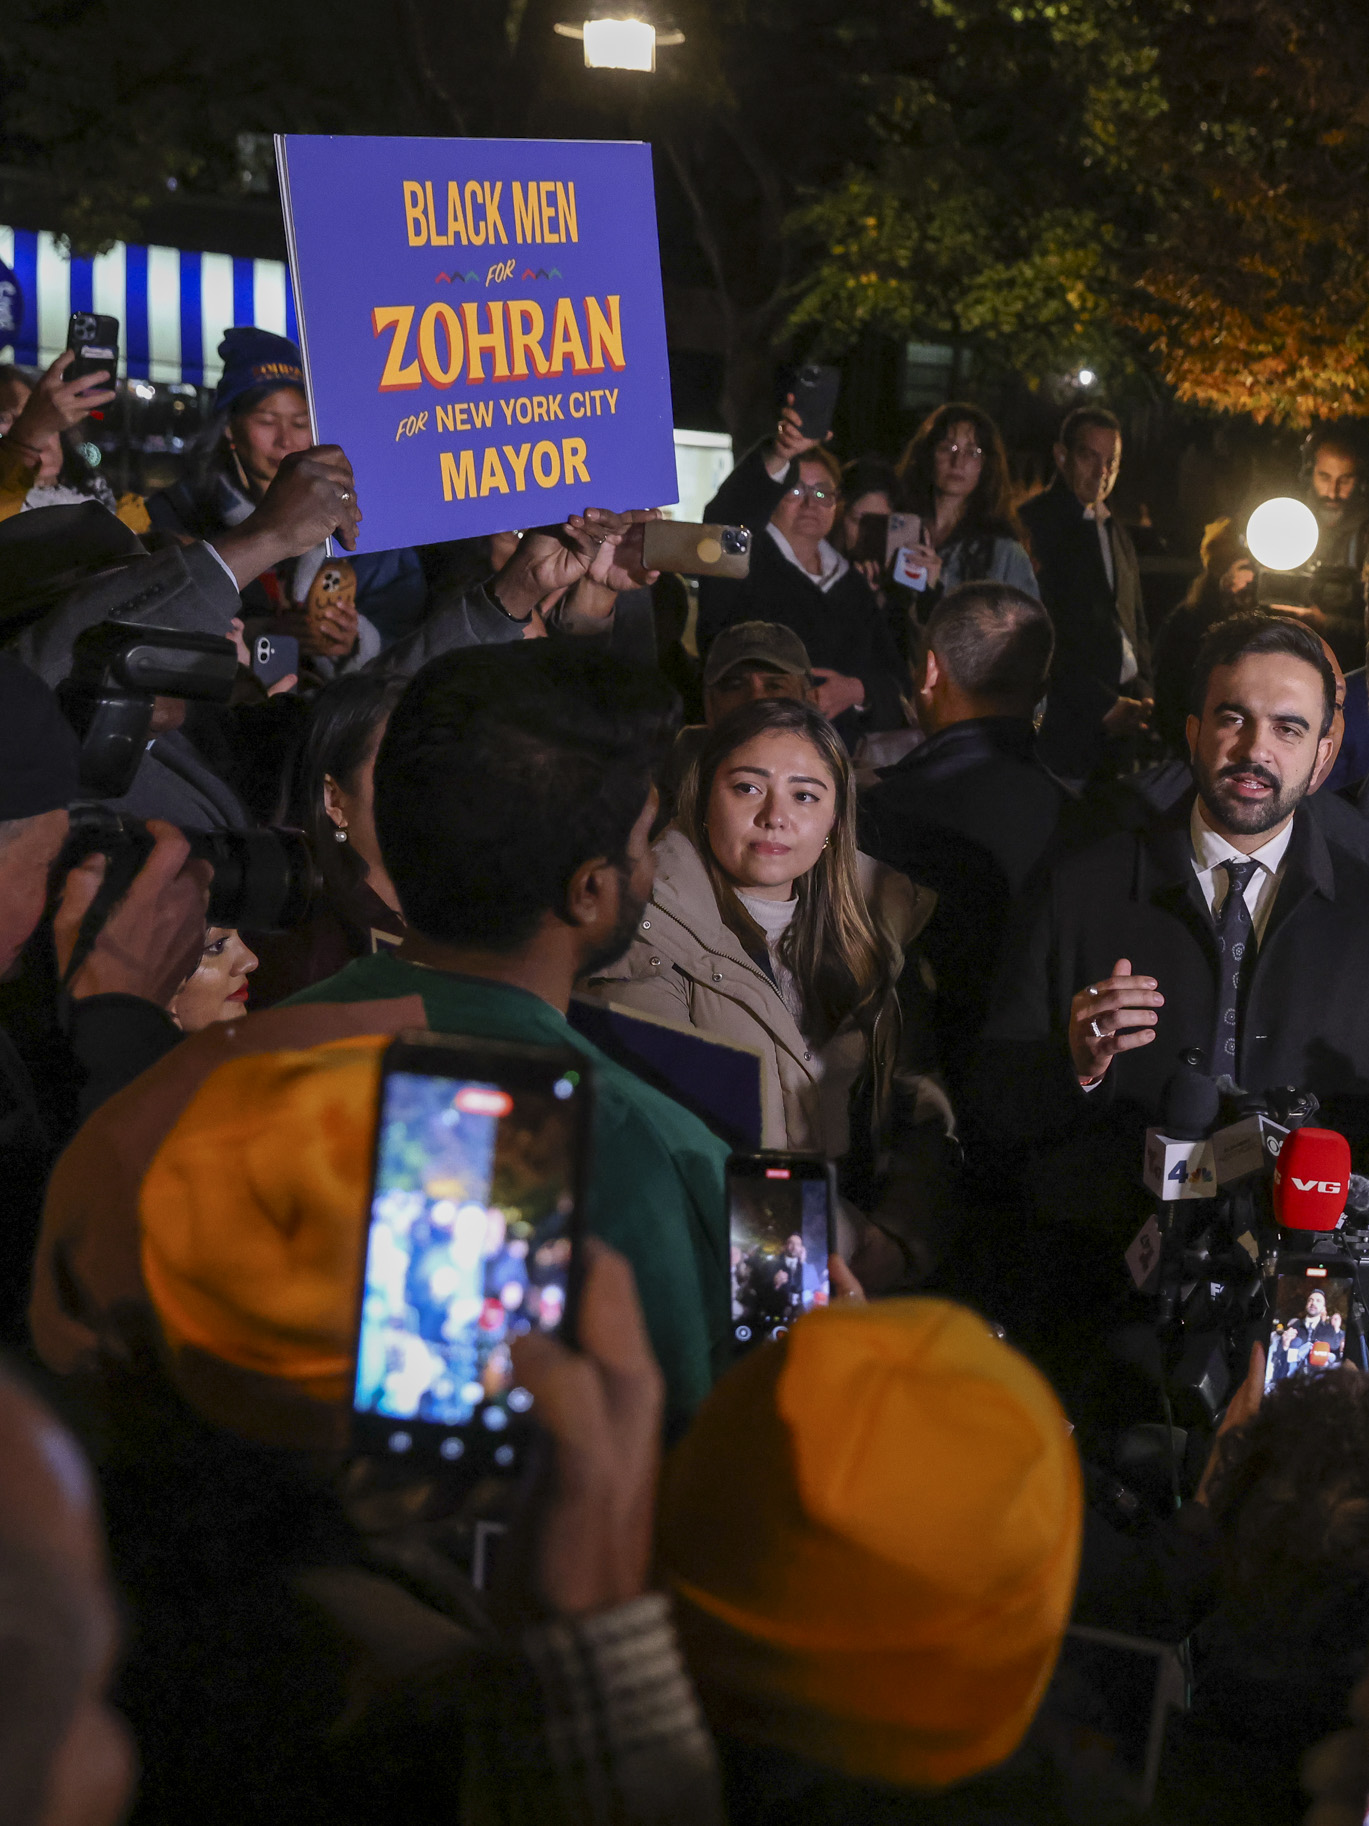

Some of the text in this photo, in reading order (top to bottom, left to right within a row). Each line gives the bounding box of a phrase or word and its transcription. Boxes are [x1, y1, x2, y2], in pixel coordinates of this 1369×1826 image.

[403, 180, 578, 246] BLACK MEN
[485, 259, 516, 287] FOR
[371, 295, 626, 392] ZOHRAN
[395, 388, 619, 442] FOR NEW YORK CITY
[440, 437, 591, 502] MAYOR
[1168, 1160, 1189, 1184] 4
[1291, 1178, 1341, 1194] VG
